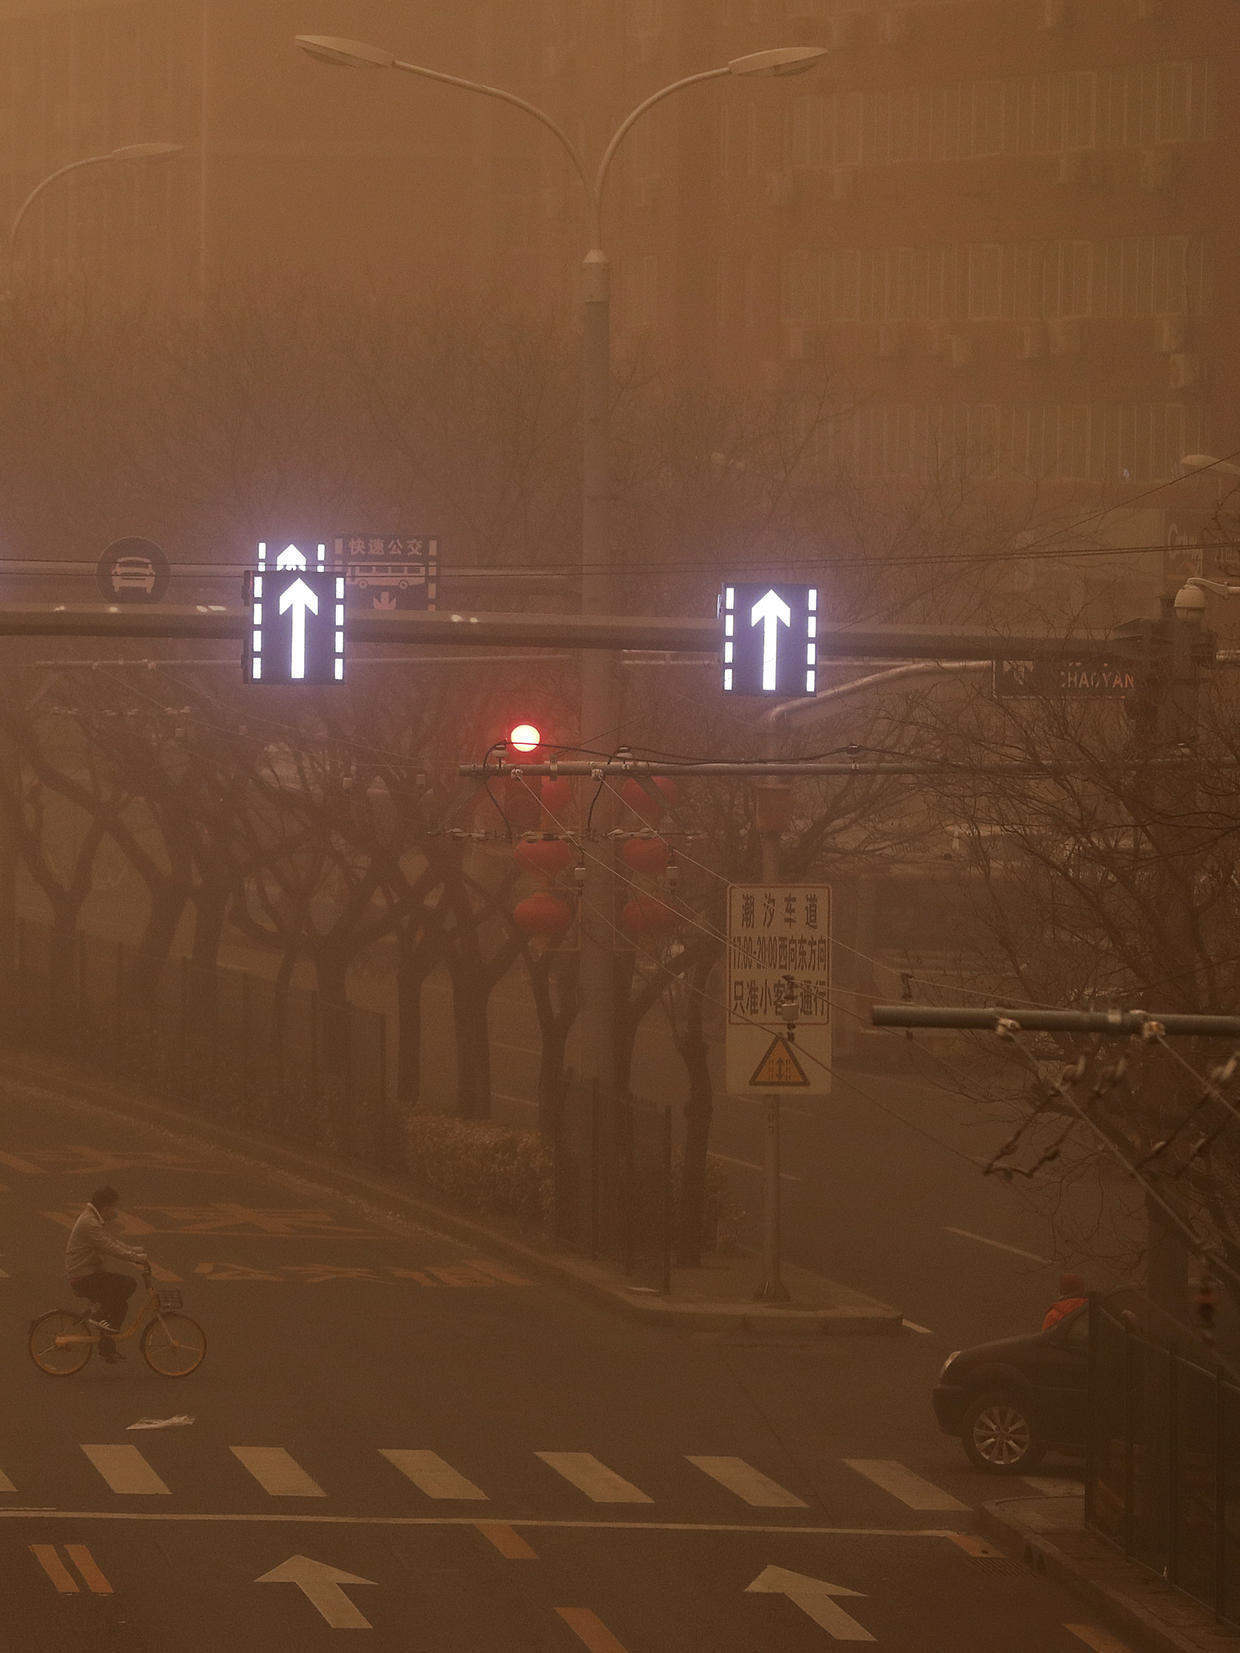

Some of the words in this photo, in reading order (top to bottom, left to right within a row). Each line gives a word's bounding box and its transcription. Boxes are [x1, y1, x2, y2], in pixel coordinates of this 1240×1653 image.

[348, 537, 424, 556] 快速公交
[741, 892, 819, 930] 潮汐车道
